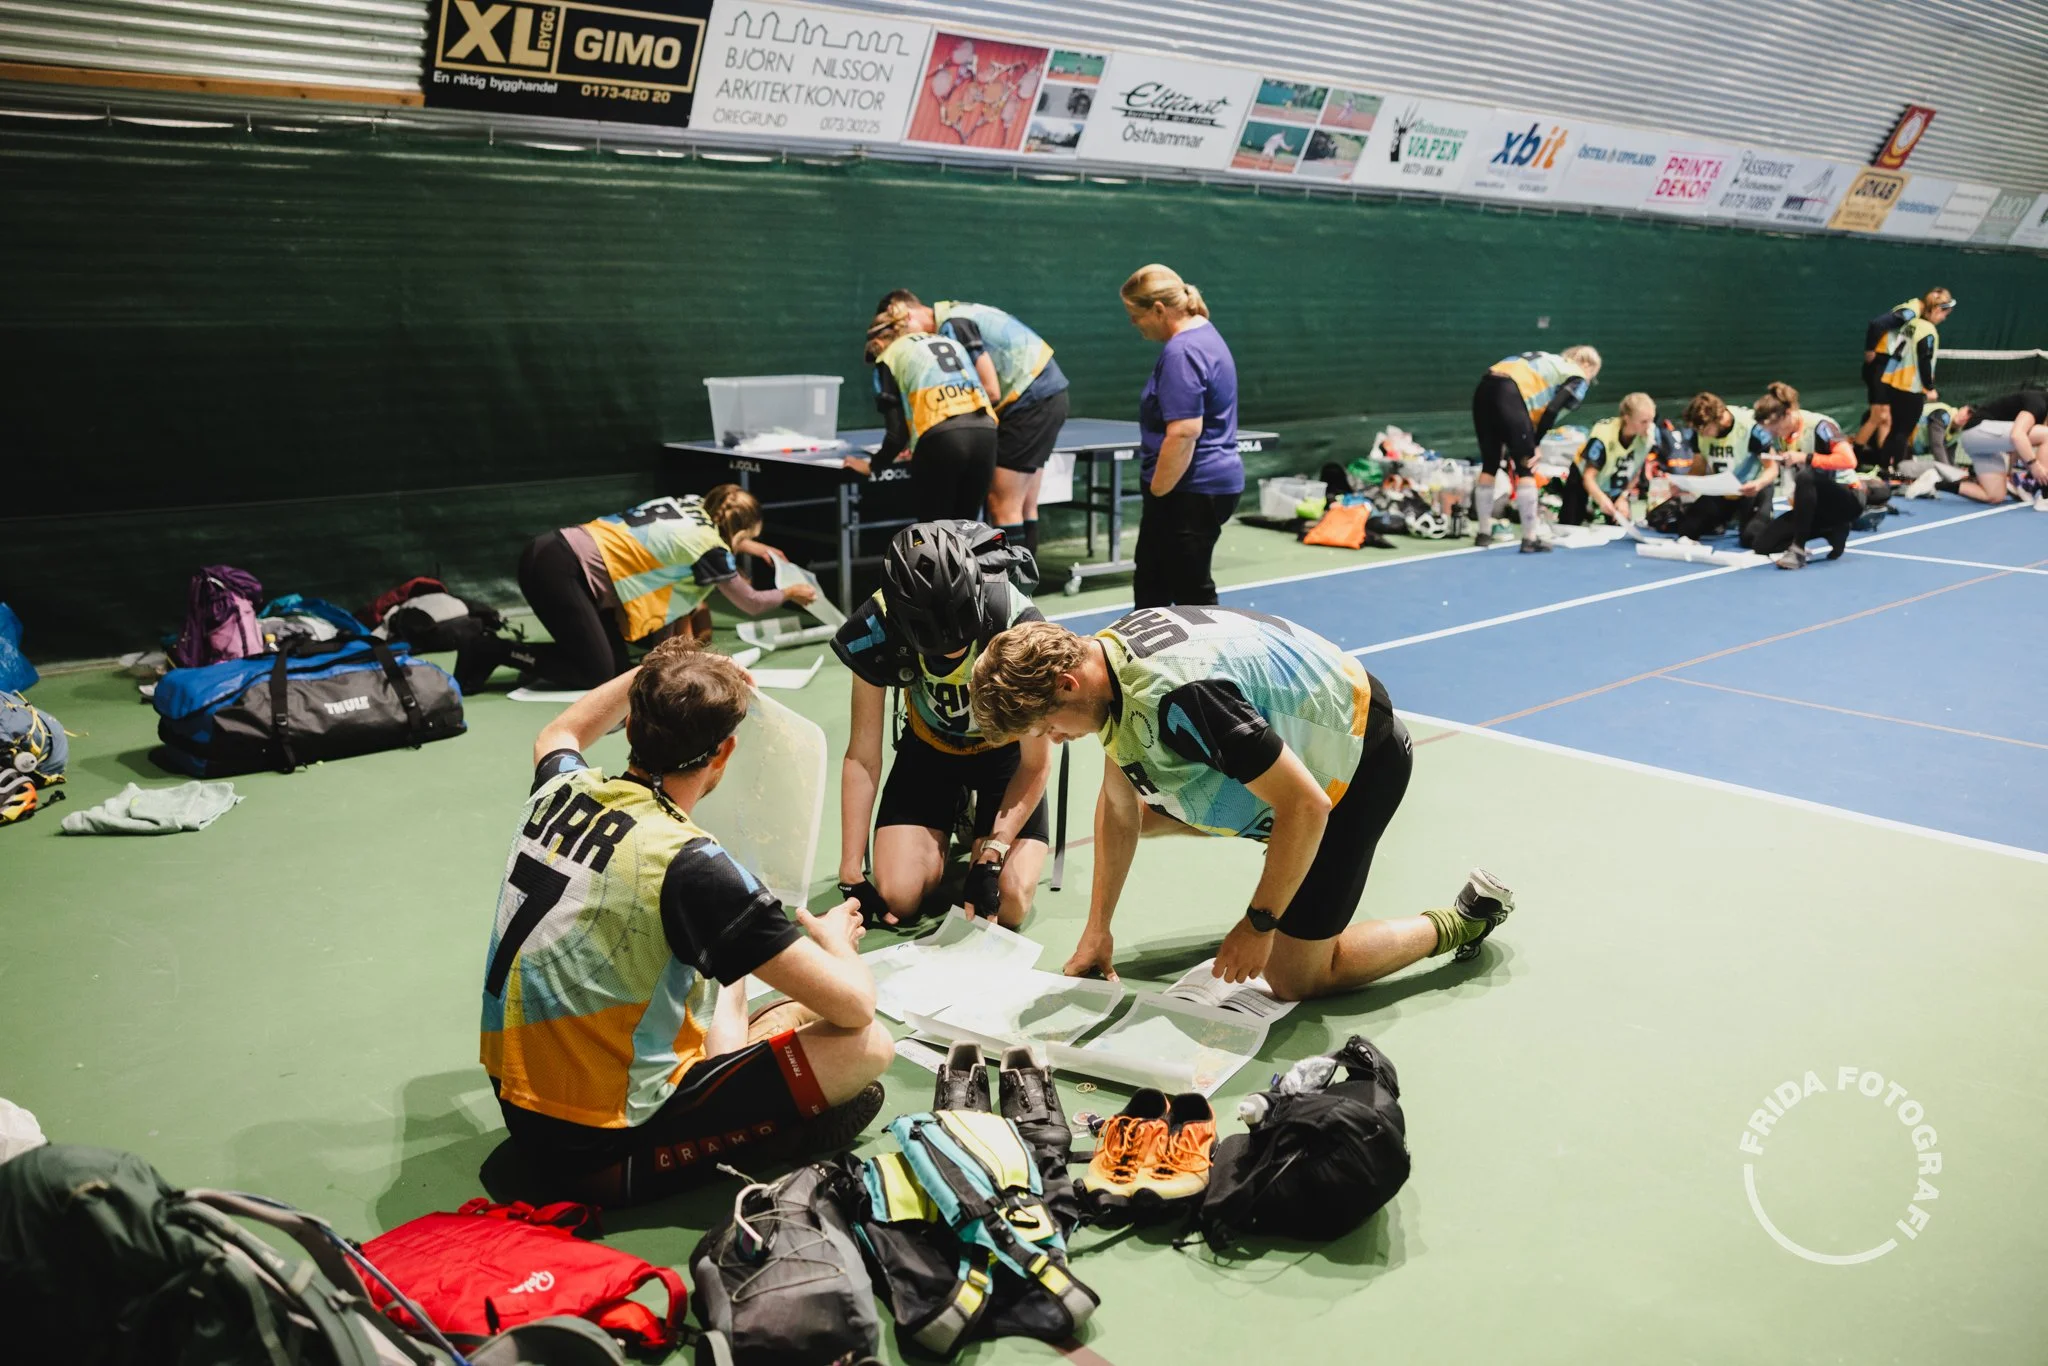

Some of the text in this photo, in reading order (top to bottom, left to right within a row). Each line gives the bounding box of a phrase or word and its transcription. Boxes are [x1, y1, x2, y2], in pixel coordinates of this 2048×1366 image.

[445, 0, 550, 68] XL
[574, 27, 682, 70] GIMO
[725, 46, 894, 82] BJÖRN NILSSON
[433, 71, 558, 95] En riktig bygghandel
[581, 84, 671, 104] 0173-420 20
[713, 107, 788, 128] ÖREGRUND
[1122, 121, 1204, 148] Östhammar
[1408, 136, 1462, 160] VAPEN
[1490, 123, 1568, 169] xbit
[1655, 178, 1712, 199] DEKOR
[928, 342, 964, 373] 8
[878, 468, 912, 481] JOOL
[323, 695, 370, 715] THULE
[485, 851, 572, 1000] 7
[783, 1045, 803, 1078] TRIMTEX
[659, 1125, 773, 1168] CRAMO
